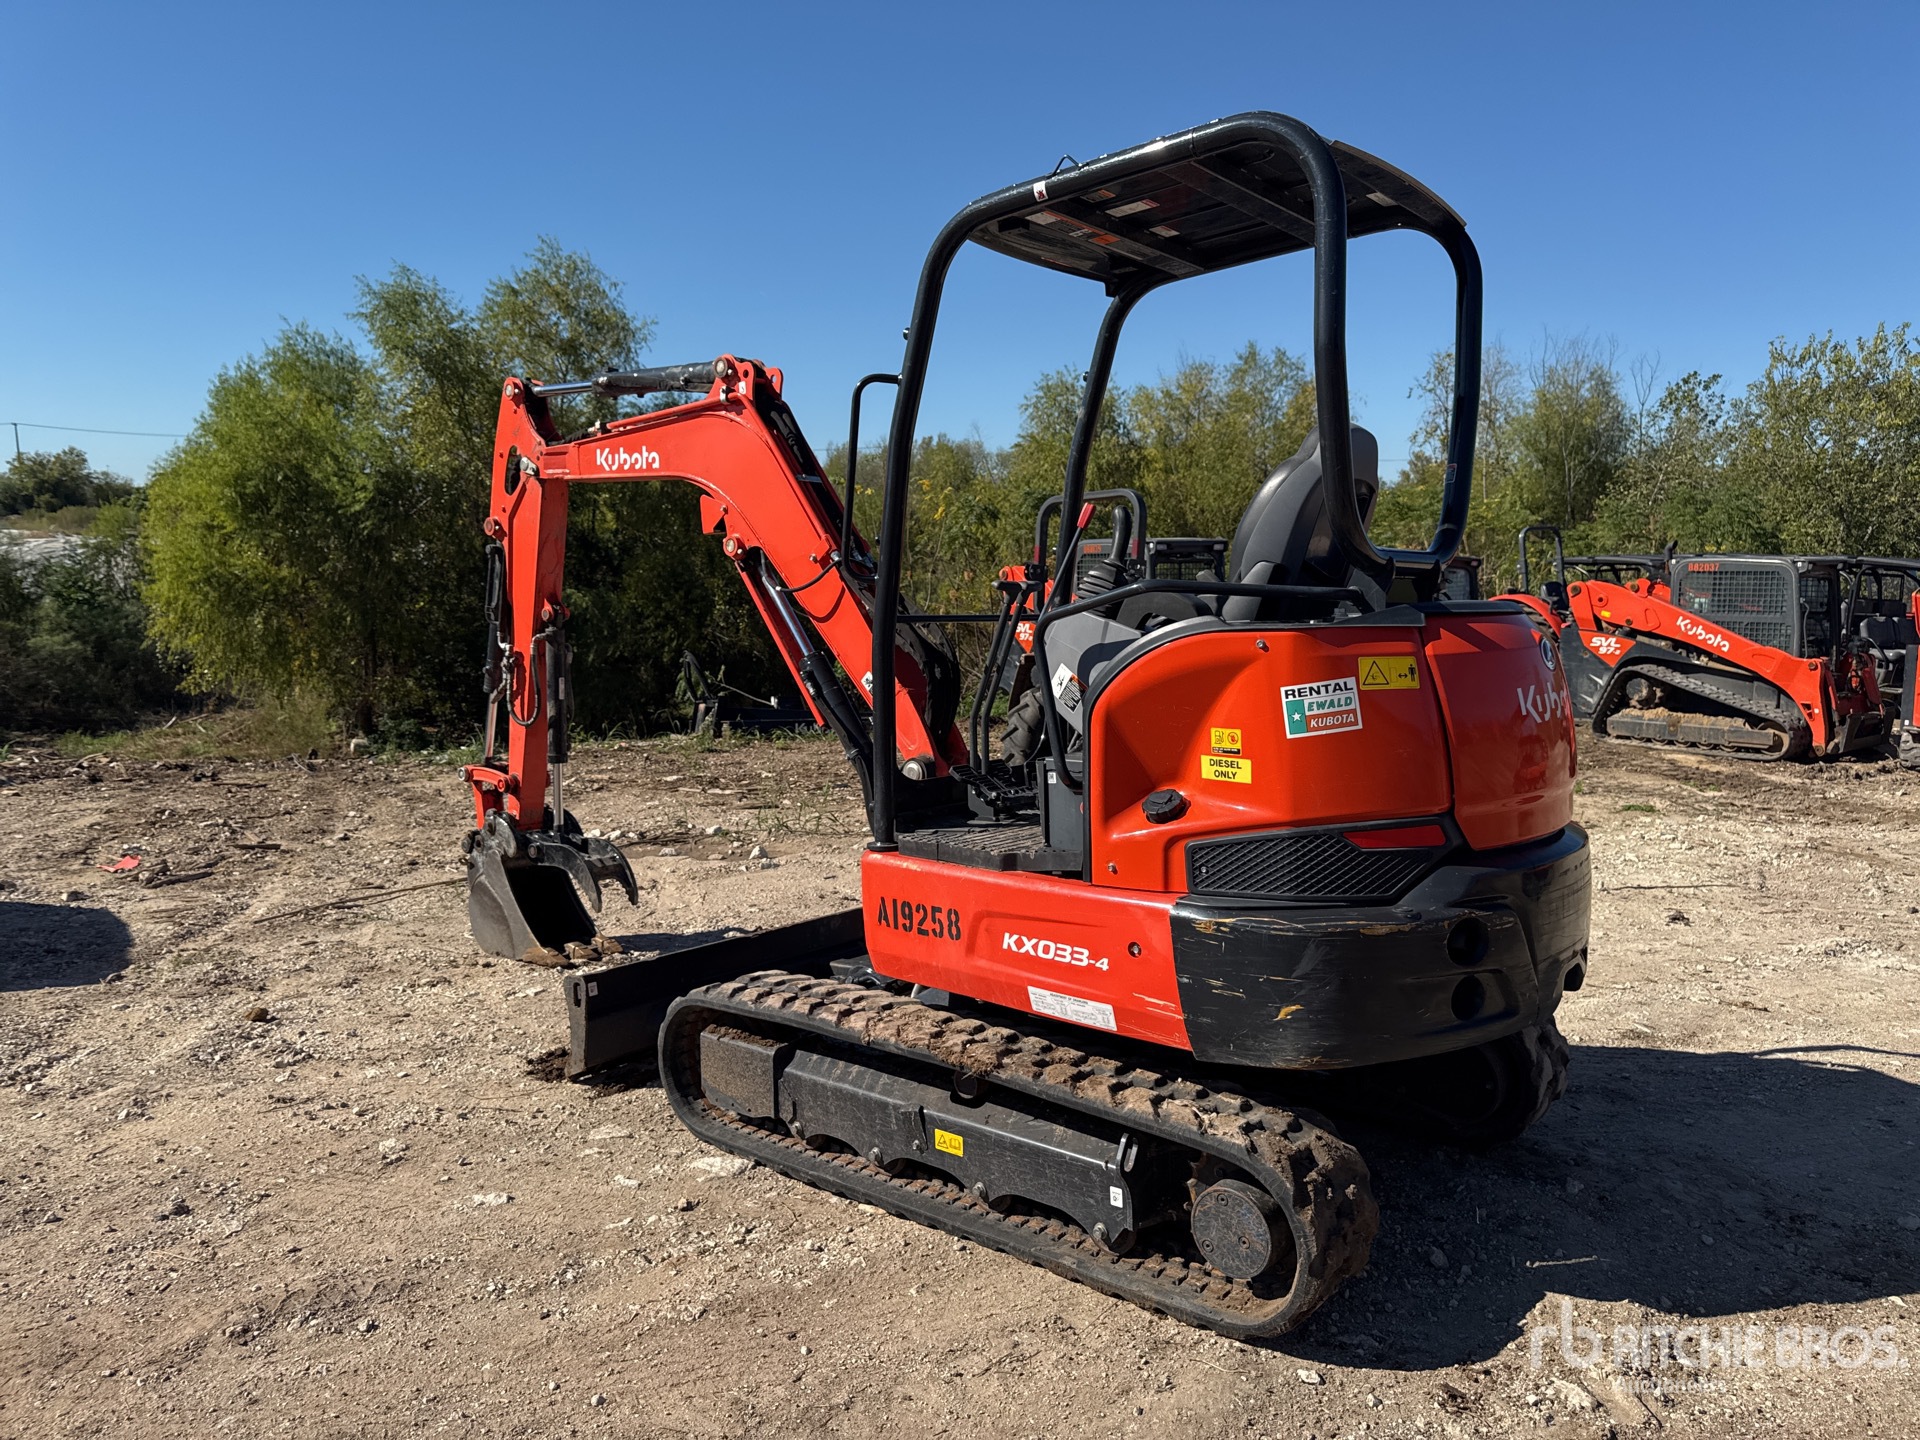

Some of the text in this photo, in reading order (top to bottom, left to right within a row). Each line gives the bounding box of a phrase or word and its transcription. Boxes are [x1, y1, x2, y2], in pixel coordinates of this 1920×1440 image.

[596, 445, 660, 472] Kubota
[1589, 636, 1621, 648] SVL
[1676, 615, 1730, 653] Kubota
[1284, 680, 1354, 700] RENTAL
[1307, 696, 1353, 712] EWALD
[1310, 713, 1355, 728] KUBOTA
[1209, 758, 1242, 770] DIESEL
[1213, 769, 1238, 780] ONLY
[1001, 931, 1110, 972] KX033-4
